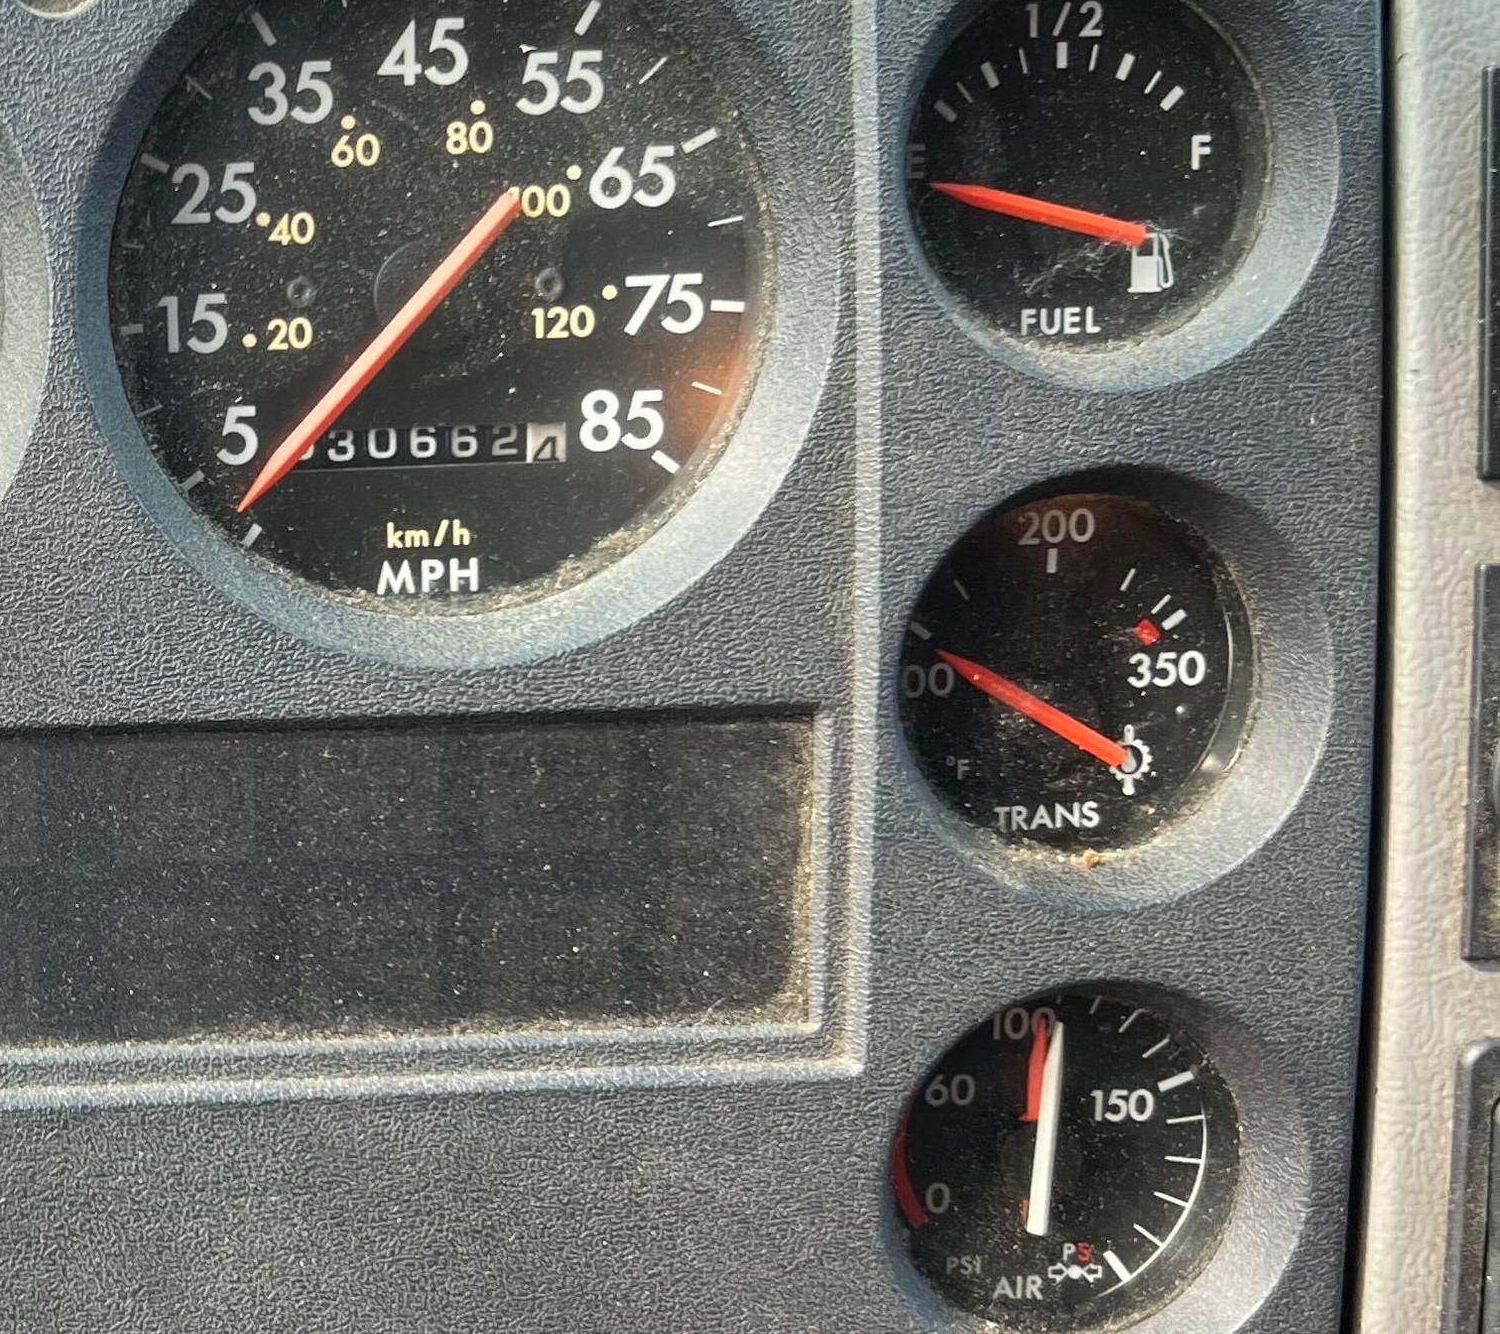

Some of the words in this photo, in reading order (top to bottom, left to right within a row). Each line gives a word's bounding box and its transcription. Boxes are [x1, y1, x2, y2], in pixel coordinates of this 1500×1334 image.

[1025, 0, 1104, 38] 1/2
[377, 17, 468, 86] 45
[247, 60, 333, 125] 35
[516, 50, 604, 115] 55
[331, 133, 380, 168] 60
[446, 122, 494, 155] 80
[1191, 134, 1212, 170] F
[171, 162, 257, 225] 25
[588, 144, 676, 211] 65
[268, 211, 315, 246] 40
[530, 305, 595, 339] 120
[625, 273, 703, 337] 75
[1020, 307, 1101, 336] FUEL
[158, 293, 228, 355] 15
[266, 317, 313, 351] 20
[215, 405, 259, 466] 5
[579, 389, 664, 453] 85
[301, 424, 562, 463] 306624
[386, 521, 471, 549] km/h
[1017, 508, 1095, 546] 200
[377, 558, 480, 595] MPH
[902, 662, 954, 698] 00
[1127, 650, 1205, 688] 350
[997, 801, 1100, 832] TRANS
[925, 1074, 975, 1105] 60
[1090, 1089, 1155, 1123] 150
[926, 1183, 951, 1214] 0
[992, 1275, 1044, 1301] AIR
